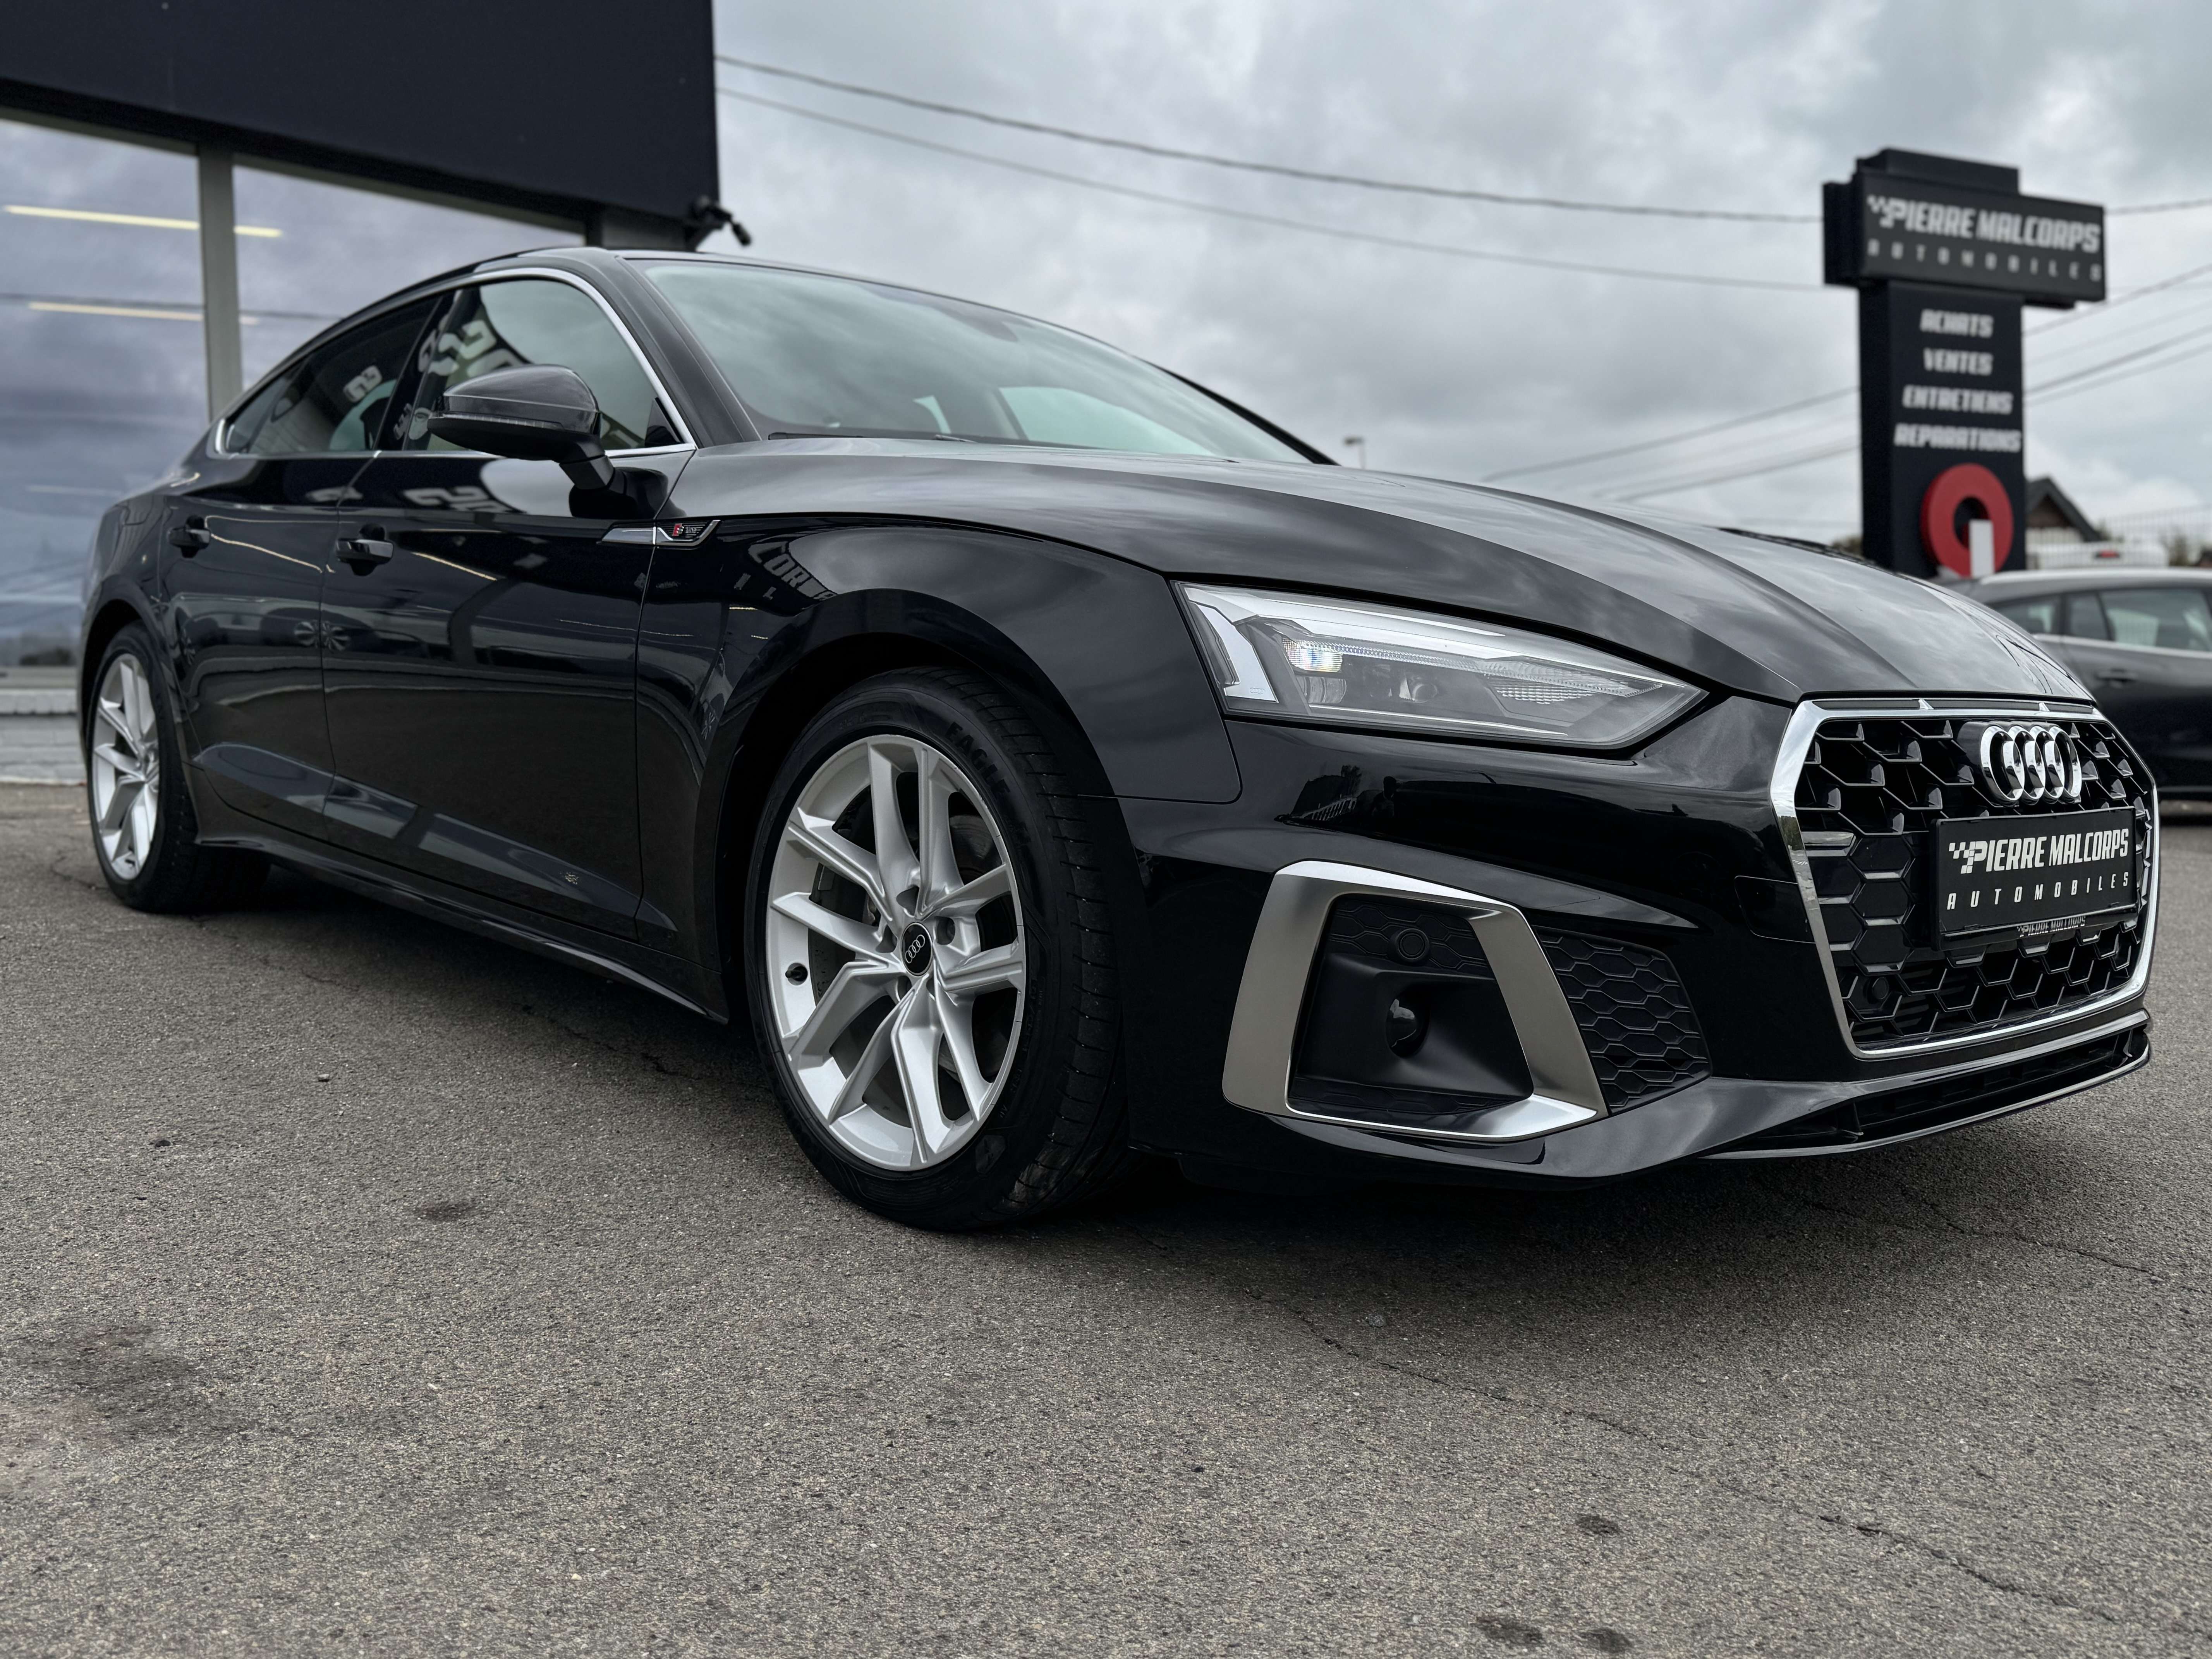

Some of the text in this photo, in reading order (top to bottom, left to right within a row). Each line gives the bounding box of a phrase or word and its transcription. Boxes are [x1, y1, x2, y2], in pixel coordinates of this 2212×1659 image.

[1877, 197, 2101, 253] PIERRE MALCORPS
[1868, 238, 2102, 282] AUTOMOBILES
[1920, 309, 1994, 338] ACHATS
[1923, 348, 1993, 376] VENTES
[1902, 385, 2014, 415] ENTRETIENS
[1894, 423, 2021, 453] REPARATIONS
[1959, 828, 2129, 874] PIERRE MALCORPS
[1947, 871, 2128, 910] AUTOMOBILES
